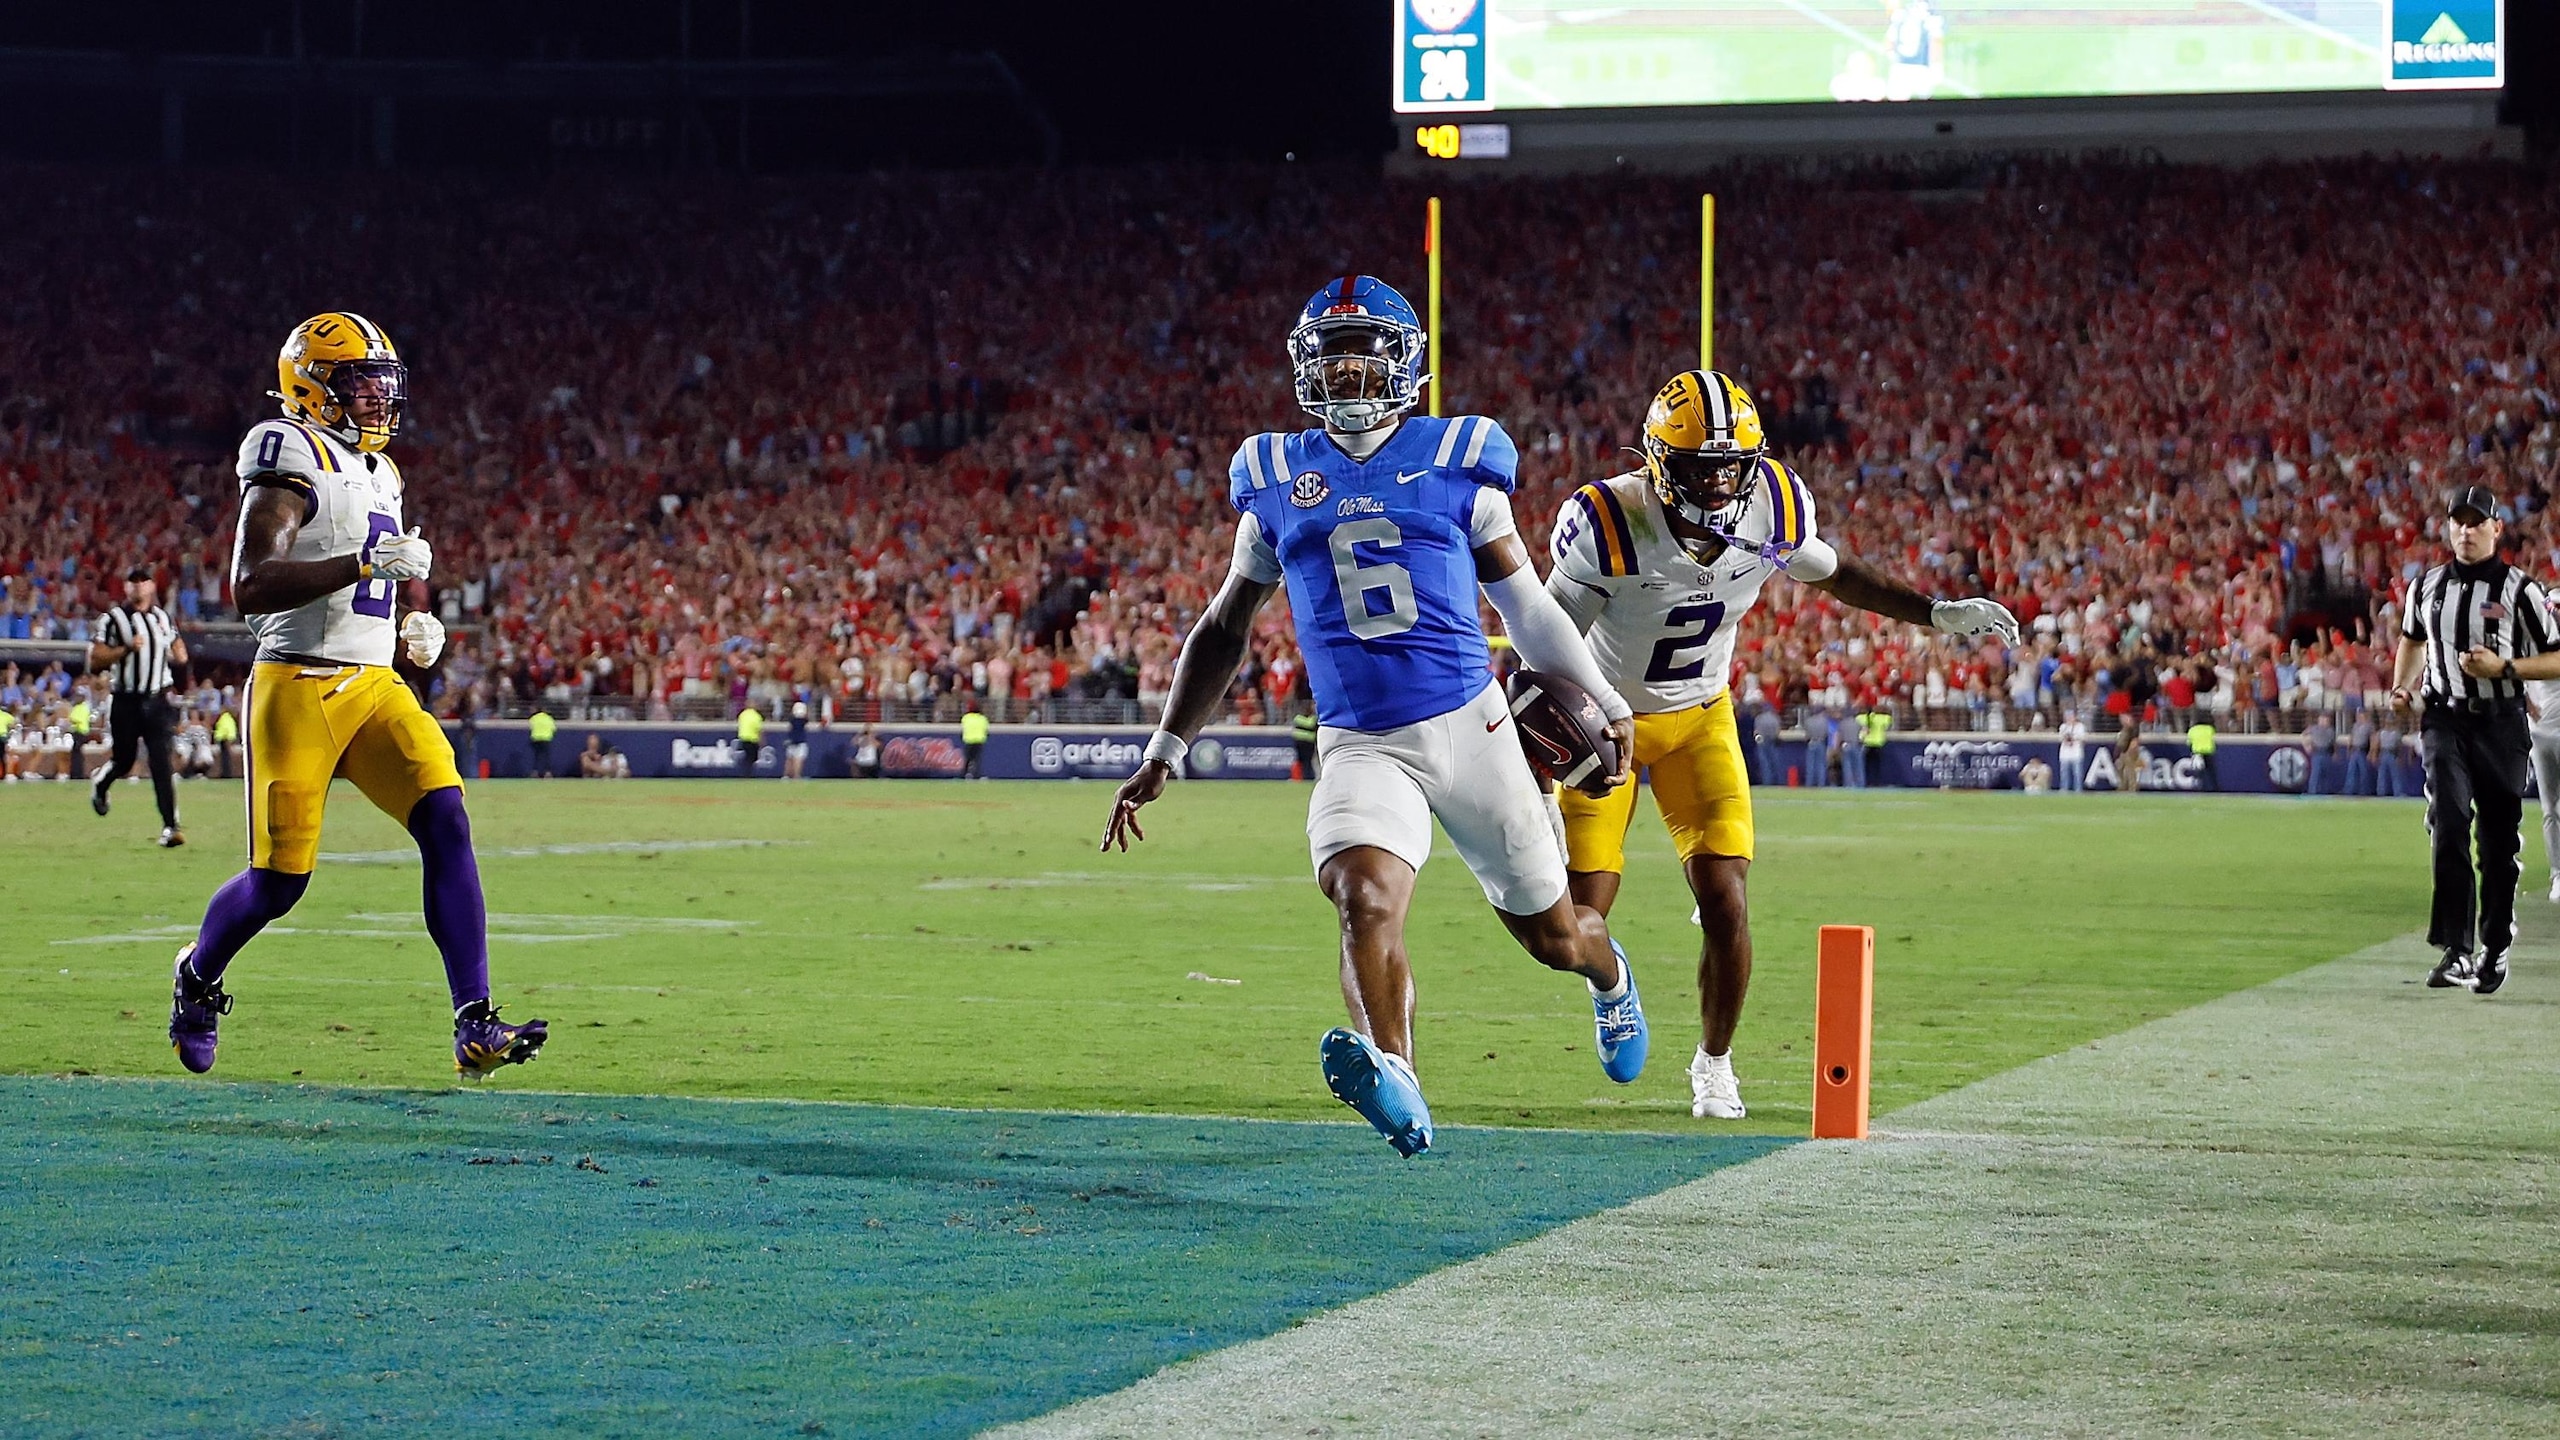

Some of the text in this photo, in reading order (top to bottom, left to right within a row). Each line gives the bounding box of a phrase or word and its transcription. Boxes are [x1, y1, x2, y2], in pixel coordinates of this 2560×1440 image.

[2393, 40, 2496, 64] REGIONS
[1416, 124, 1460, 159] 40
[257, 430, 285, 468] 0
[1295, 472, 1322, 499] SEC
[1337, 496, 1385, 517] Ole Miss
[1555, 517, 1580, 559] 2
[1328, 517, 1420, 641] 6
[1687, 592, 1714, 602] LSU
[1643, 601, 1726, 682] 2
[1062, 738, 1143, 766] arden
[1911, 754, 2021, 771] PEARL RIVER
[2084, 745, 2197, 789] Alac
